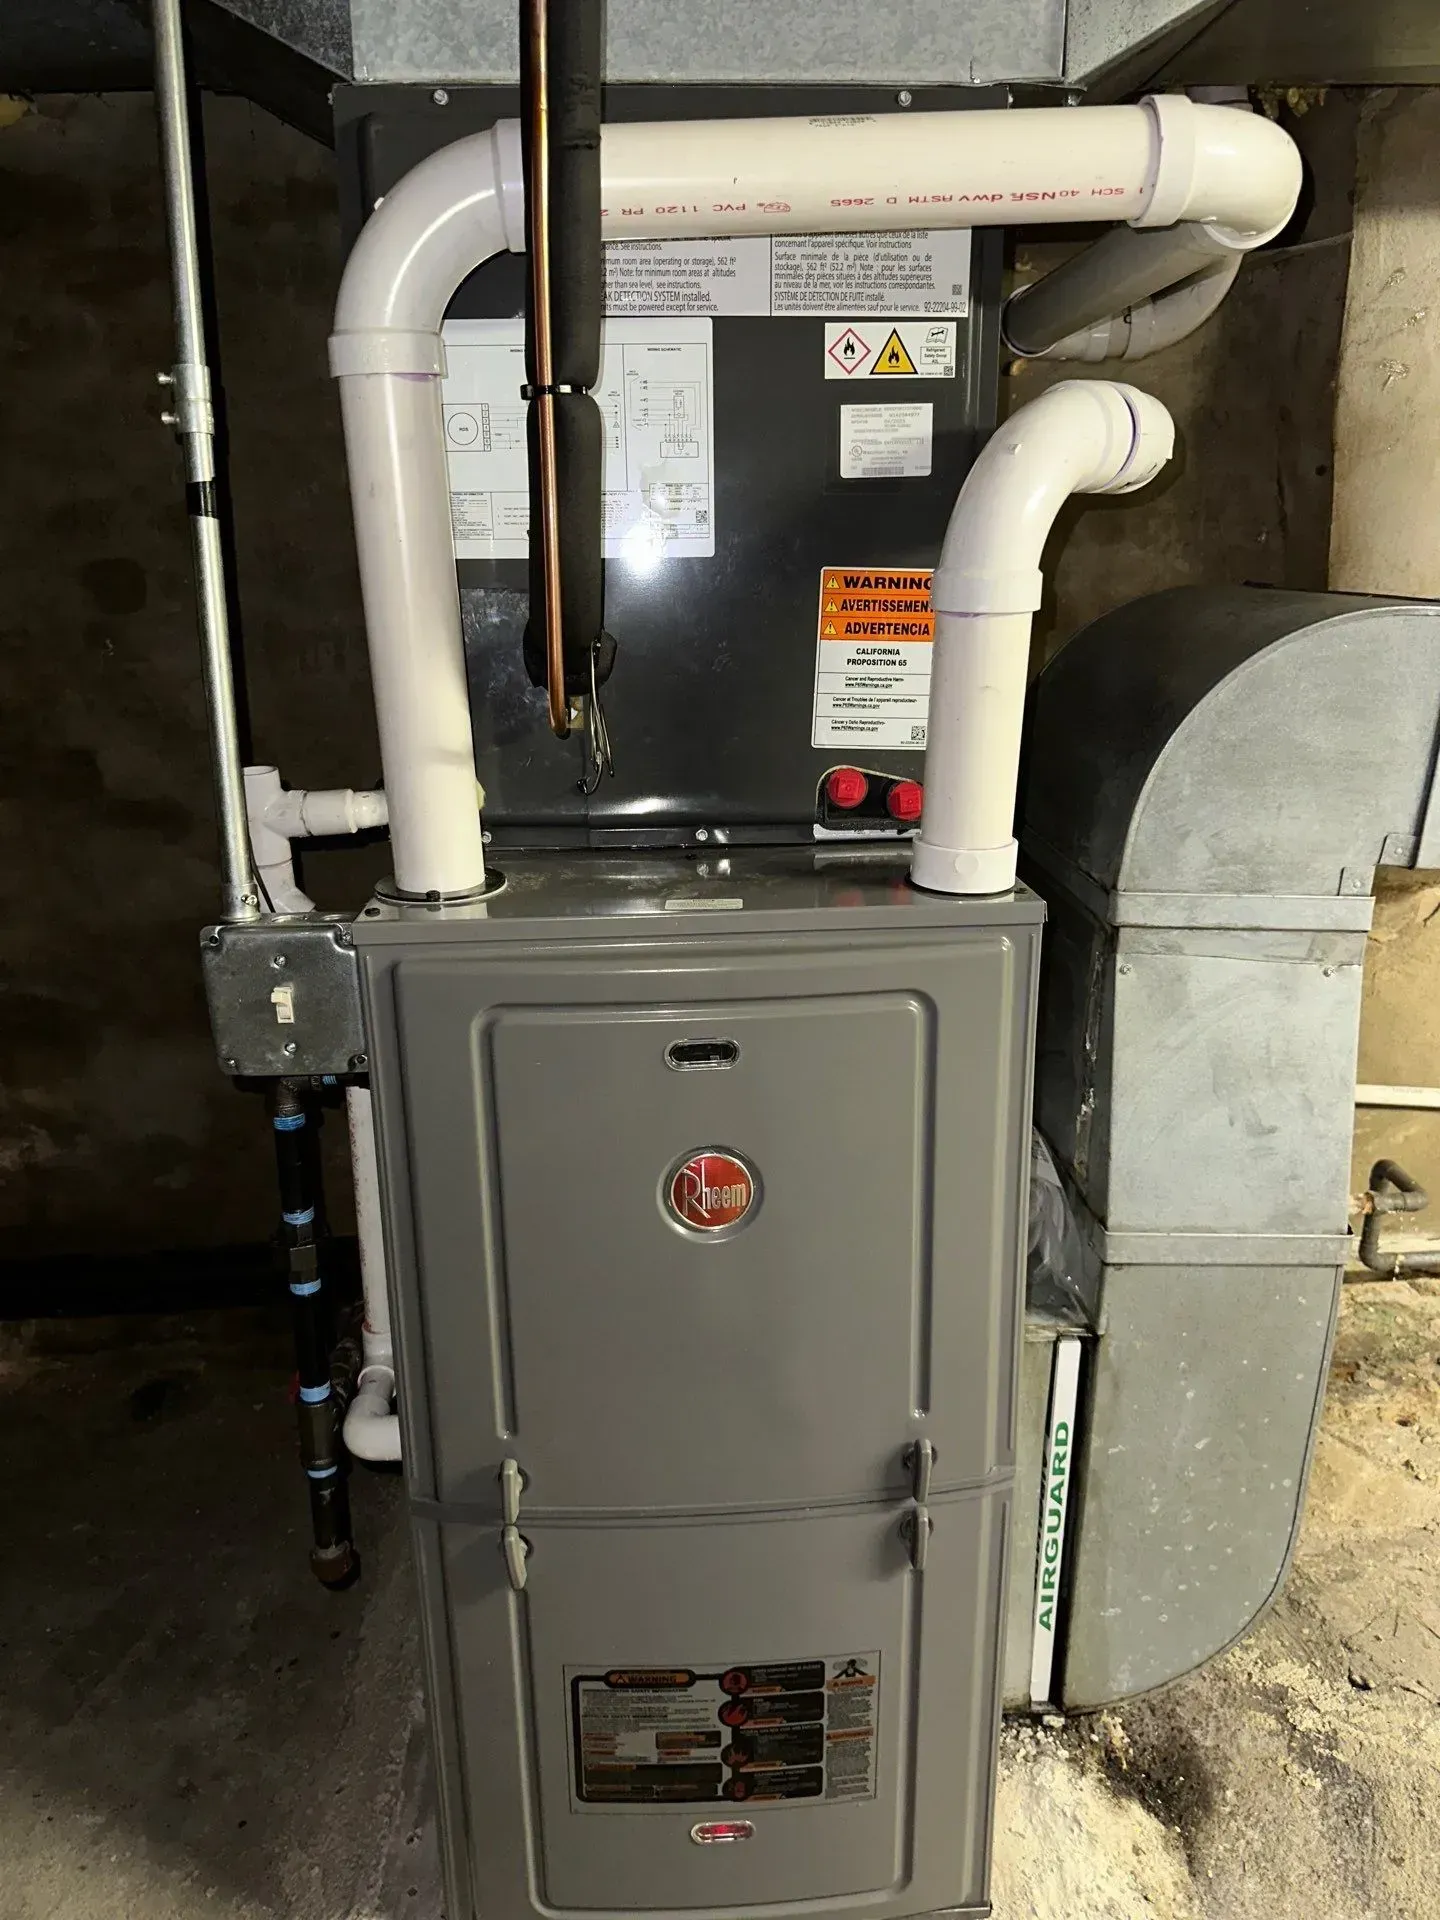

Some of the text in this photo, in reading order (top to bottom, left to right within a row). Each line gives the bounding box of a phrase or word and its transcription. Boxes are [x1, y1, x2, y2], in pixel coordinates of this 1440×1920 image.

[1091, 187, 1125, 196] SCH
[830, 197, 875, 207] 2665
[886, 197, 898, 205] D
[908, 194, 953, 204] ASTM
[621, 207, 645, 216] PR
[655, 205, 699, 214] 1120
[712, 203, 746, 212] PVC
[620, 243, 630, 251] See
[774, 240, 806, 248] concernant
[866, 240, 878, 248] Voir
[878, 240, 912, 248] instructions
[774, 252, 796, 260] Surface
[801, 252, 827, 260] minimale
[653, 256, 682, 267] (operating
[718, 256, 728, 265] 562
[644, 267, 671, 277] minimum
[688, 269, 703, 277] areas
[712, 267, 736, 277] altitudes
[806, 263, 818, 271] 562
[860, 263, 874, 271] Note
[881, 264, 895, 273] pour
[909, 263, 932, 271] surfaces
[774, 272, 804, 280] minimales
[805, 272, 815, 280] des
[862, 272, 872, 280] des
[874, 272, 898, 281] altitudes
[614, 281, 628, 289] than
[614, 291, 652, 301] DETECTION
[654, 291, 680, 301] SYSTEM
[681, 291, 712, 301] installed.
[774, 290, 798, 301] SYSTÈME
[849, 292, 864, 301] FUITE
[613, 303, 628, 311] must
[638, 302, 664, 313] powered
[666, 303, 686, 313] except
[802, 302, 823, 311] doivent
[867, 302, 878, 311] sauf
[880, 304, 893, 314] pour
[840, 598, 934, 612] AVERTISSEMEN
[844, 622, 930, 635] ADVERTENCIA
[847, 658, 896, 666] PROPOSITION
[682, 1159, 747, 1218] Rheem
[1039, 1421, 1069, 1632] AIRGUARD
